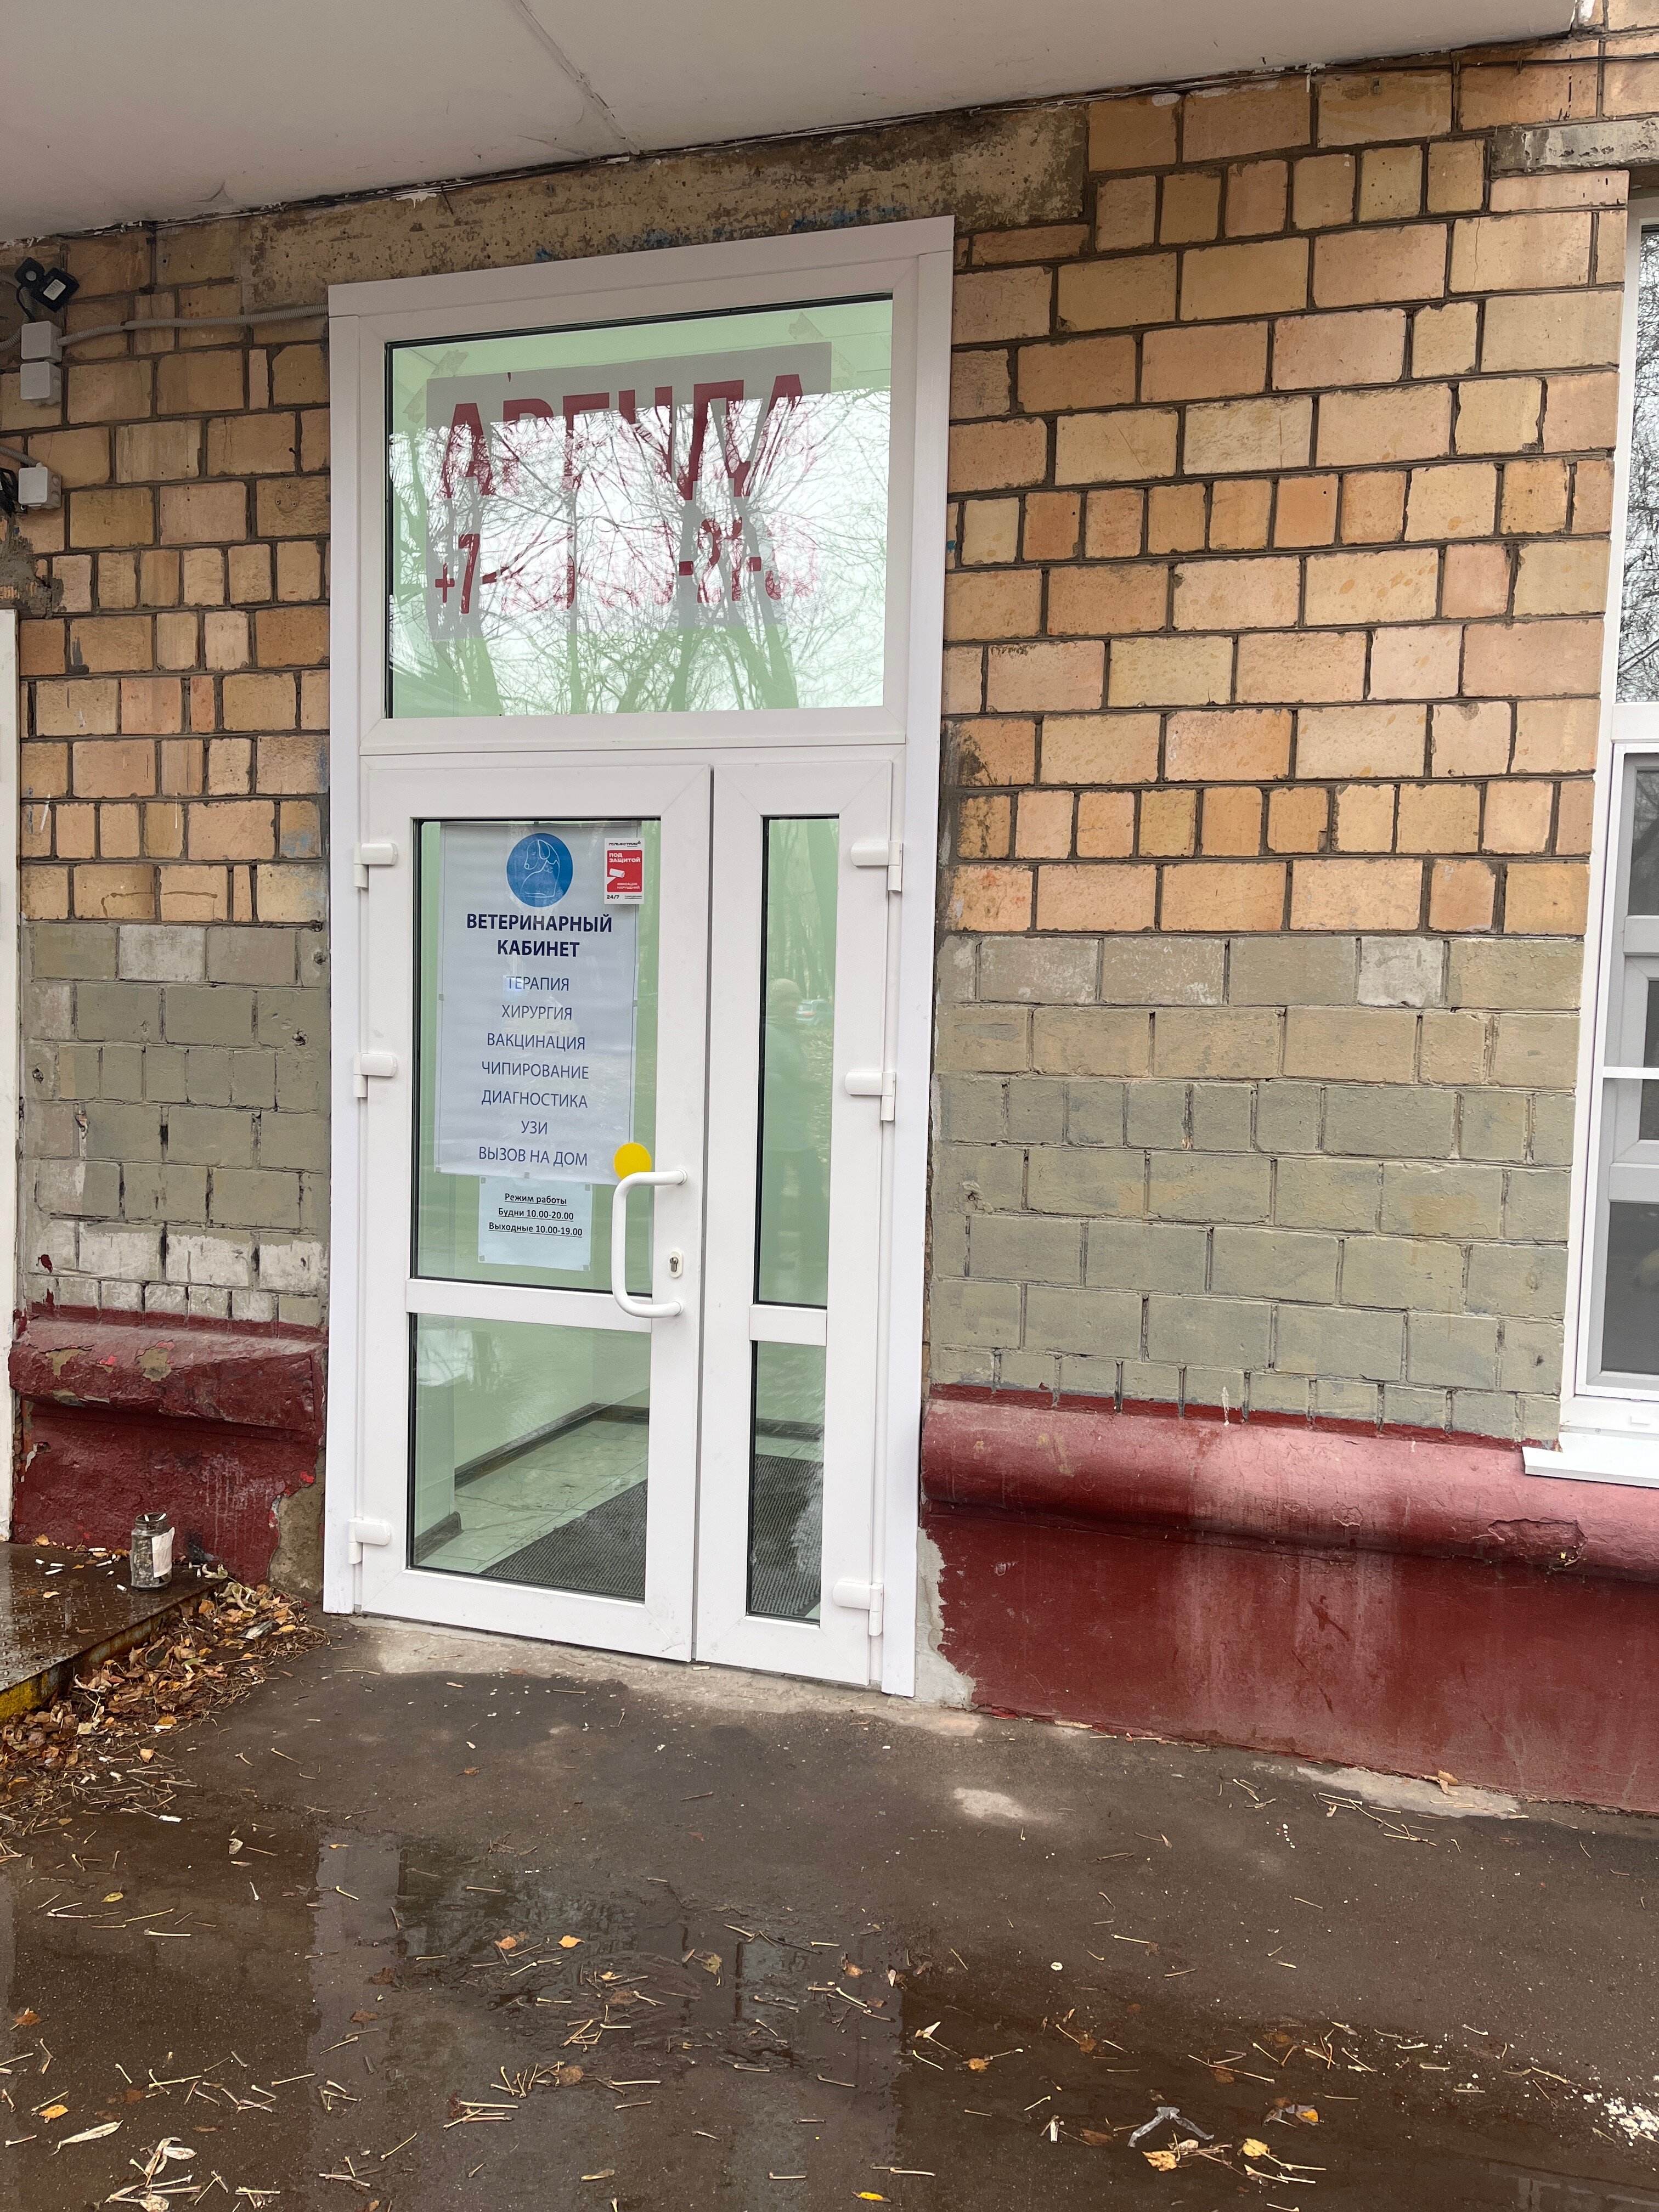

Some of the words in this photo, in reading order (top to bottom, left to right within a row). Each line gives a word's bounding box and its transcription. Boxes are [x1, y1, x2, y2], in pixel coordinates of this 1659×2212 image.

[467, 913, 612, 933] ВЕТЕРИНАРНЫЙ
[498, 939, 580, 957] КАБИНЕТ
[506, 976, 569, 991] ТЕРАПИЯ
[501, 1005, 572, 1020] ХИРУРГИЯ
[487, 1033, 585, 1052] ВАКЦИНАЦИЯ
[482, 1061, 589, 1080] ЧИПИРОВАНИЕ
[481, 1090, 588, 1108] ДИАГНОСТИКА
[521, 1120, 548, 1135] УЗИ
[479, 1147, 526, 1162] ВЫЗОВ
[530, 1150, 550, 1164] НА
[553, 1152, 588, 1167] ДОМ
[505, 1193, 534, 1202] Режим
[536, 1195, 567, 1205] работы
[498, 1207, 524, 1217] Будни
[526, 1210, 574, 1220] 10.00-20.00
[489, 1222, 534, 1232] Выходные
[535, 1225, 583, 1236] 10.00-19.00
